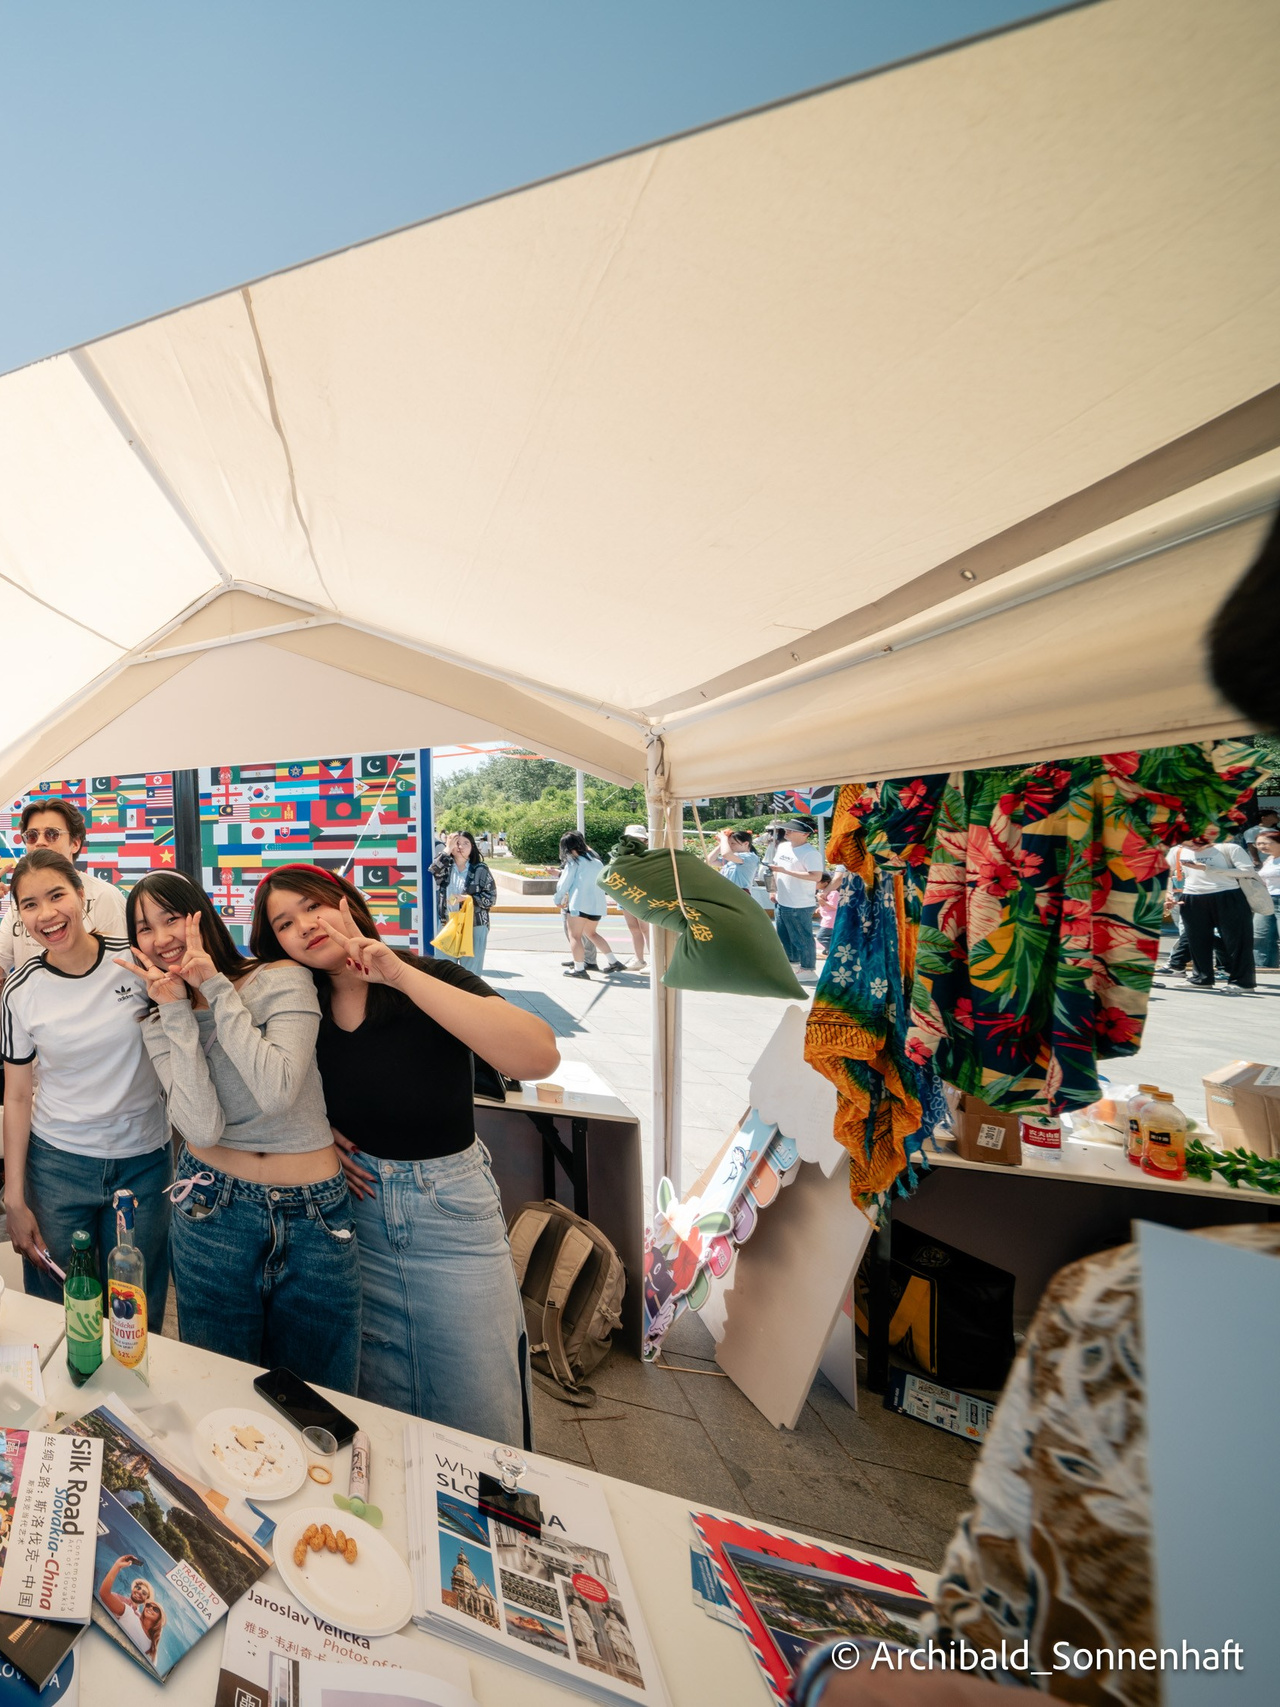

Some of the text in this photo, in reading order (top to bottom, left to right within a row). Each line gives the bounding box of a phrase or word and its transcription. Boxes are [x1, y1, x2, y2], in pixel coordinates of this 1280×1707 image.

[62, 1438, 91, 1536] Silk Road
[437, 1472, 567, 1532] SLOIA
[39, 1487, 69, 1611] Slovakia-China
[60, 1571, 70, 1612] Slovakia
[68, 1539, 83, 1613] Contemporary
[170, 1574, 212, 1621] GOOD IDEA
[176, 1569, 210, 1606] SLOVAKIA
[182, 1564, 220, 1606] TRAVEL TO
[248, 1589, 310, 1626] Jaroslav
[323, 1637, 369, 1665] Photos
